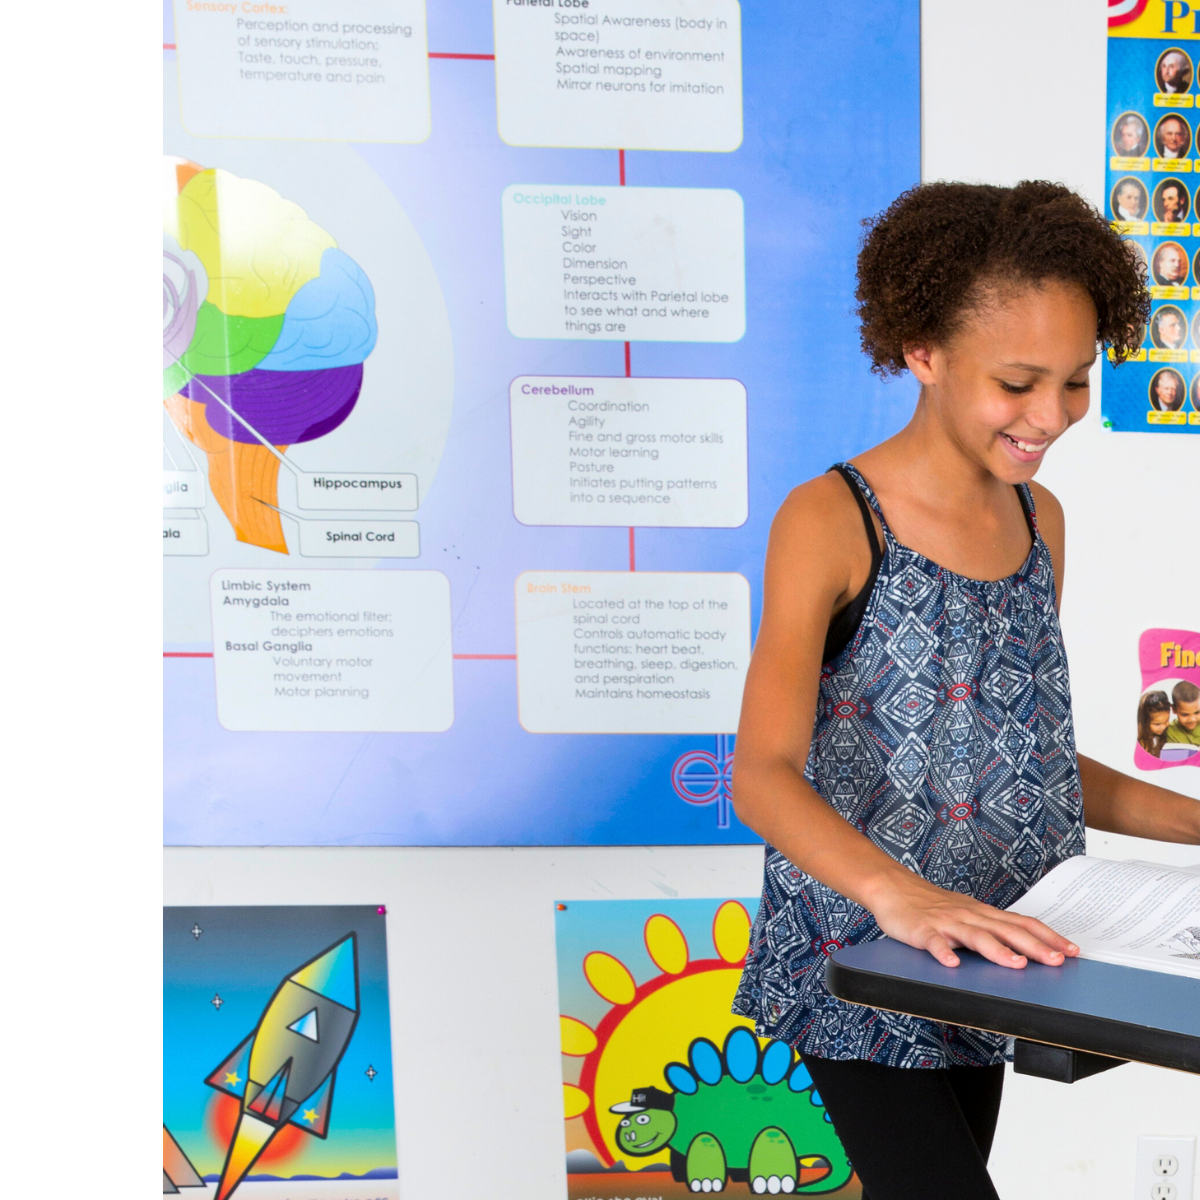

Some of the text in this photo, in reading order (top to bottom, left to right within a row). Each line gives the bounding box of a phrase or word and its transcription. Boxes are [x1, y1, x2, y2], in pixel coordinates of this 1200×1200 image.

[187, 0, 289, 14] Sensory Cortex:
[237, 18, 412, 37] Perception and processing
[554, 13, 713, 30] Spatial Awareness (body
[555, 30, 599, 43] space)
[254, 37, 302, 49] sensory
[556, 47, 725, 62] Awareness environment
[240, 69, 385, 84] temperature and pain
[556, 63, 662, 78] Spatial mapping
[557, 80, 724, 94] Mirror neurons for imitation
[513, 193, 606, 206] Occipital Lobe
[561, 210, 597, 221] Vision
[562, 226, 591, 239] Sight
[562, 242, 596, 253] Color
[563, 258, 627, 269] Dimension
[564, 274, 636, 286] Perspective
[564, 289, 729, 303] Interacts with Parietal lobe
[581, 306, 709, 318] see what and where
[565, 321, 626, 333] things are
[522, 385, 594, 396] Cerebellum
[568, 400, 649, 412] Coordination
[569, 416, 605, 429] Agility
[569, 431, 723, 444] Fine and gross motor skills
[570, 447, 658, 459] Motor learning
[570, 462, 614, 473] Posture
[314, 478, 402, 491] Hippocampus
[570, 477, 717, 490] Initiates putting patterns
[570, 493, 670, 505] into sequence
[327, 532, 395, 543] Spinal Cord
[222, 581, 311, 593] Limbic System
[528, 583, 591, 593] Brain Stem
[223, 596, 289, 608] Amygdala
[573, 599, 728, 611] Located the top the
[271, 612, 359, 622] The emotional
[573, 614, 640, 626] spinal cord
[272, 627, 394, 638] deciphers emotions
[574, 628, 726, 641] Controls automatic body
[226, 641, 312, 653] Basal Ganglia
[574, 644, 668, 654] functions: heart
[273, 656, 372, 669] Voluntary motor
[575, 659, 738, 671] breathing, sleep, digestion,
[274, 672, 342, 682] movement
[575, 674, 674, 686] and perspiration
[275, 687, 369, 699] Motor planning
[575, 689, 710, 699] Maintains homeostasis
